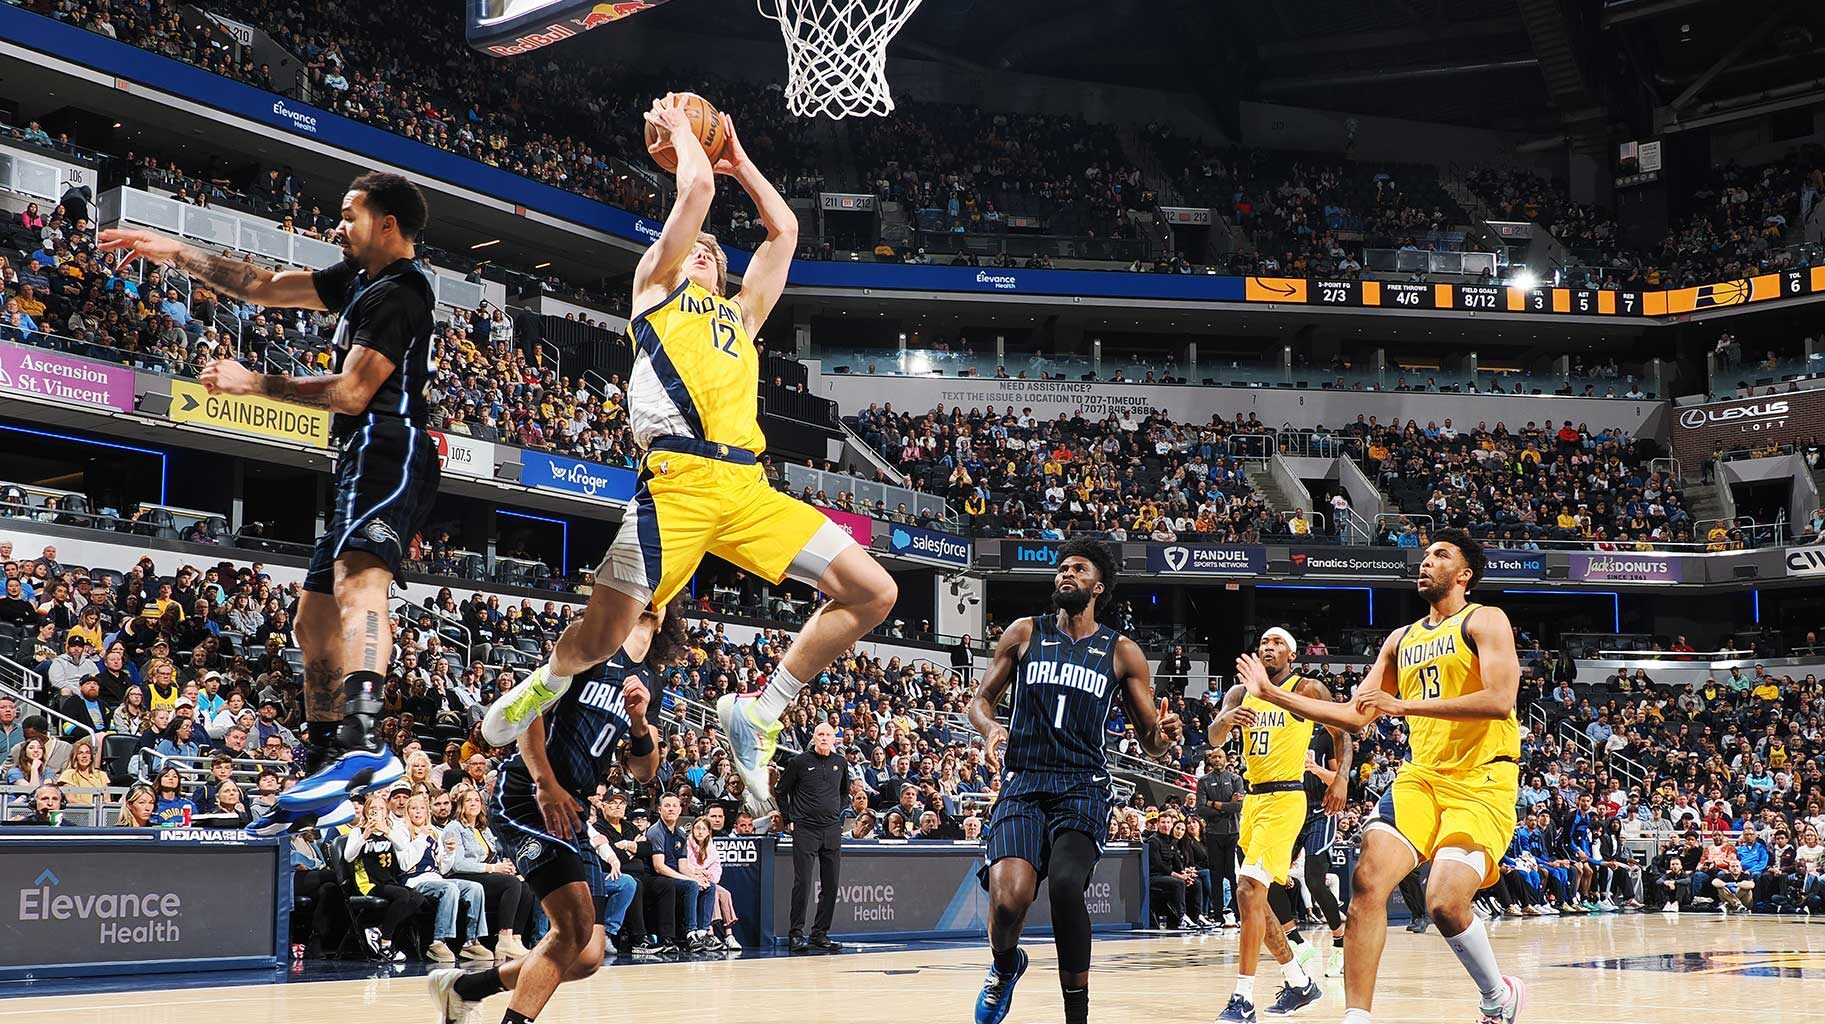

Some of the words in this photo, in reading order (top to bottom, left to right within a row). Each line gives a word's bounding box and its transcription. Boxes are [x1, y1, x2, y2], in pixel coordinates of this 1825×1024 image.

[233, 27, 249, 42] 210
[273, 102, 317, 125] Elevance
[294, 120, 317, 133] Health
[69, 169, 82, 183] 106
[825, 197, 837, 207] 211
[857, 199, 871, 208] 212
[1194, 213, 1207, 222] 213
[635, 222, 662, 238] Elevan
[976, 273, 1016, 283] Elevance
[1791, 280, 1801, 293] 6
[1323, 289, 1346, 302] 2/3
[1396, 293, 1419, 305] 4/6
[1464, 295, 1496, 308] 8/12
[680, 292, 739, 324] INDAN
[1534, 297, 1544, 310] 3
[1580, 299, 1589, 312] 5
[1624, 300, 1634, 313] 7
[710, 317, 739, 359] 12
[20, 353, 108, 385] Ascension
[18, 374, 41, 393] St.
[42, 378, 110, 405] Vincent
[1000, 382, 1024, 391] NEED
[1027, 383, 1092, 393] ASSISTANCE?
[942, 391, 964, 400] TEXT
[966, 392, 984, 401] THE
[986, 392, 1014, 401] ISSUE
[1024, 393, 1070, 403] LOCATION
[1071, 395, 1083, 404] TO
[1085, 395, 1149, 406] 707-TIMEOUT.
[206, 397, 321, 437] GAINBRIDGE
[1081, 404, 1106, 415] (707)
[1708, 401, 1789, 421] LEXUS
[1741, 421, 1785, 431] LOFT
[451, 447, 472, 462] 107.5
[568, 464, 608, 495] Kroger
[912, 534, 966, 557] salesforce
[1017, 546, 1060, 565] Indy
[1193, 550, 1249, 561] FANDUEL
[1307, 557, 1348, 568] Fanatics
[1349, 559, 1405, 570] Sportsbook
[1498, 561, 1521, 569] Tech
[1523, 561, 1540, 570] HQ
[1615, 562, 1668, 573] DONUTS
[1401, 634, 1455, 669] INDIANA
[1026, 661, 1108, 698] ORLANDO
[1419, 665, 1440, 700] 13
[578, 680, 632, 728] ORLA
[1054, 694, 1067, 729] 1
[1255, 711, 1285, 728] IANA
[590, 722, 617, 757] 0
[1249, 731, 1269, 756] 29
[161, 830, 222, 841] INDIANA
[713, 840, 756, 851] DIANA
[814, 880, 895, 904] Evance
[19, 886, 182, 921] Elevance
[1084, 899, 1111, 914] ealth
[854, 904, 895, 921] Health
[100, 920, 180, 944] Health
